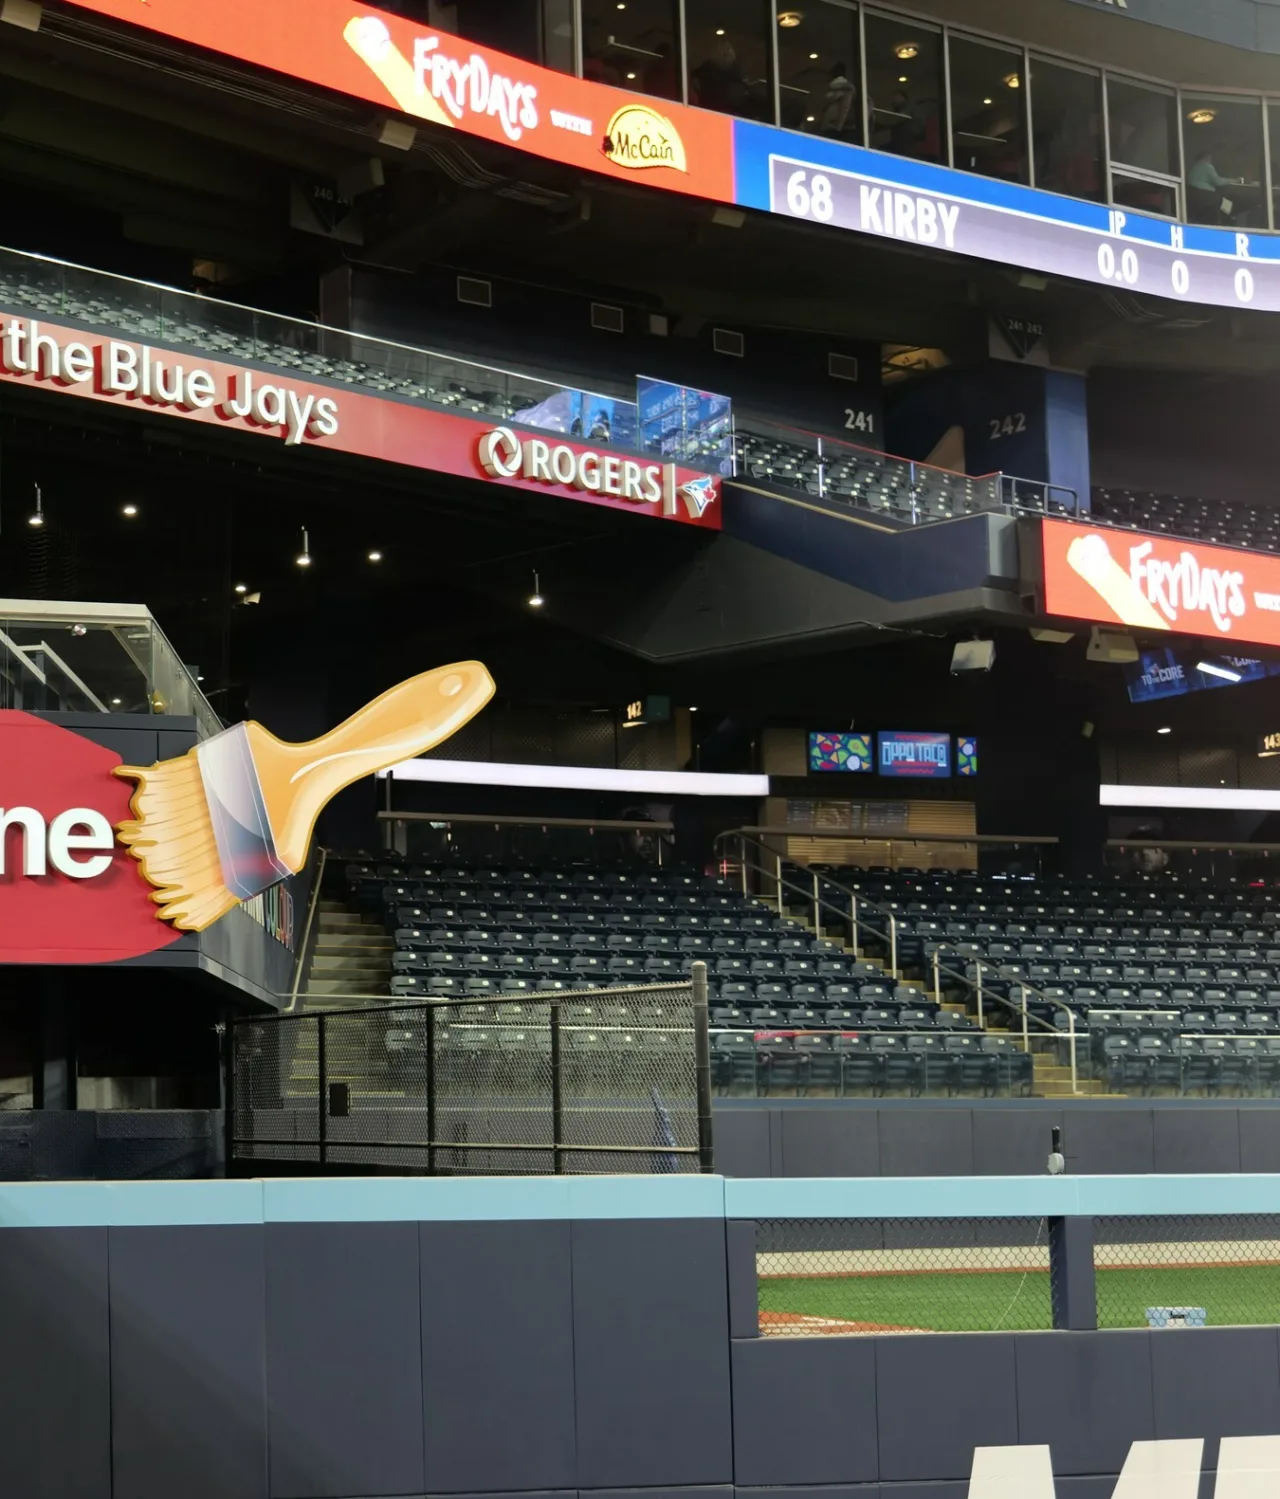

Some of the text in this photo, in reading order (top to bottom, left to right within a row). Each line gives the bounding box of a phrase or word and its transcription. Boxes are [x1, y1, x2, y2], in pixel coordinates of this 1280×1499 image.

[614, 131, 675, 162] McCain
[786, 170, 960, 249] 68 KIRBY
[1108, 210, 1249, 258] IP H R
[1096, 242, 1254, 302] 0.0 0 0
[1, 319, 94, 384] the
[104, 342, 216, 409] Blue
[224, 372, 339, 446] Jays
[844, 408, 874, 433] 241
[989, 412, 1027, 440] 242
[523, 438, 661, 503] ROGERS
[1159, 664, 1185, 683] CORE
